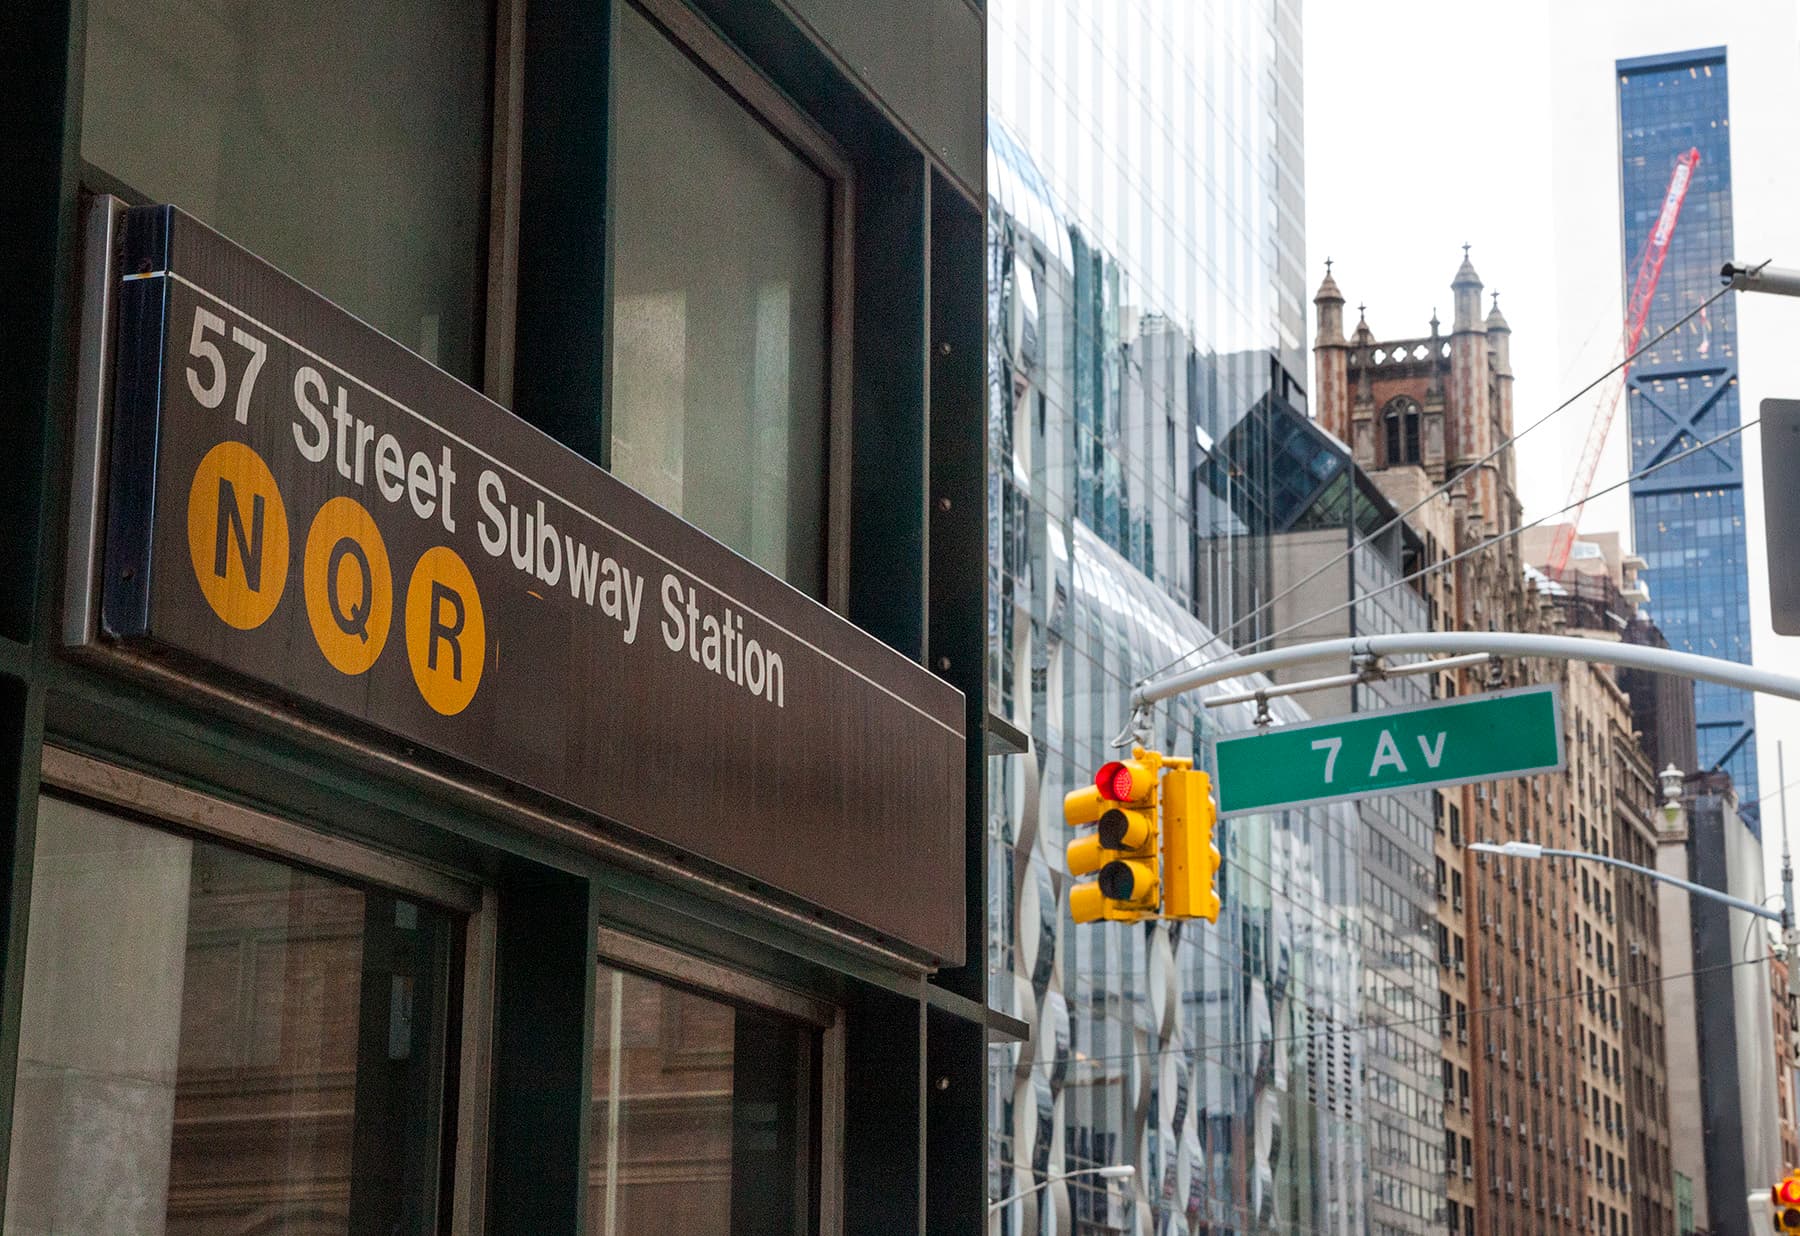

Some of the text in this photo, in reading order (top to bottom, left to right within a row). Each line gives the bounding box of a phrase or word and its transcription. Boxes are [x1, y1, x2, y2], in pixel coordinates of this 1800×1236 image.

[186, 307, 784, 708] 57 Street Subway Station
[214, 477, 465, 682] N Q R
[1311, 736, 1342, 783] 7
